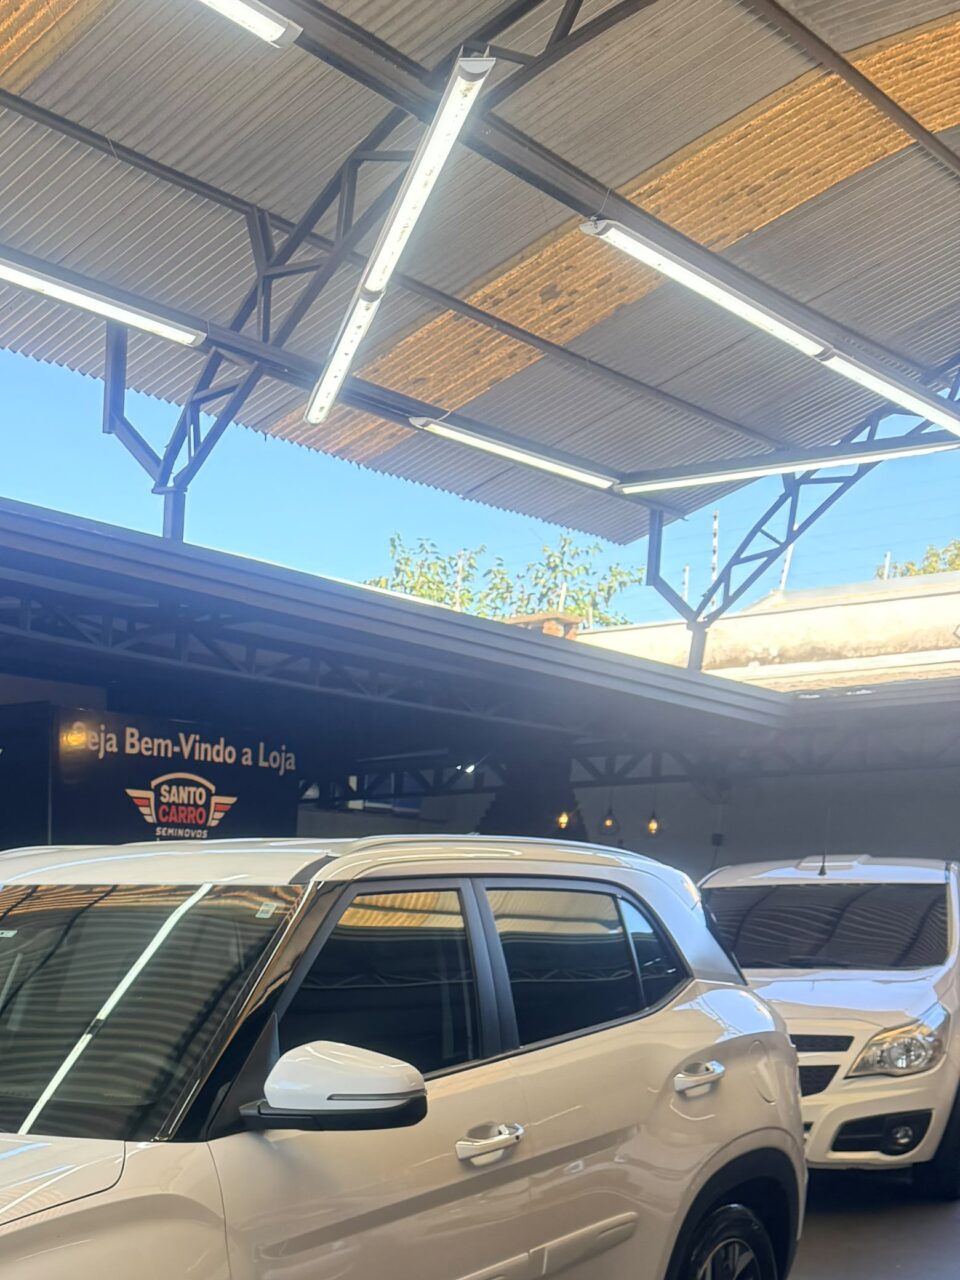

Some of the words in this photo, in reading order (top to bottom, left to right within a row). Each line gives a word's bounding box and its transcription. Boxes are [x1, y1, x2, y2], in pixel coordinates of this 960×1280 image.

[125, 726, 236, 764] Bem-Vindo
[241, 747, 253, 766] a
[258, 742, 296, 776] Loja
[160, 784, 206, 805] SANTO
[158, 804, 206, 825] CARRO
[155, 826, 208, 839] SEMINOVOS
